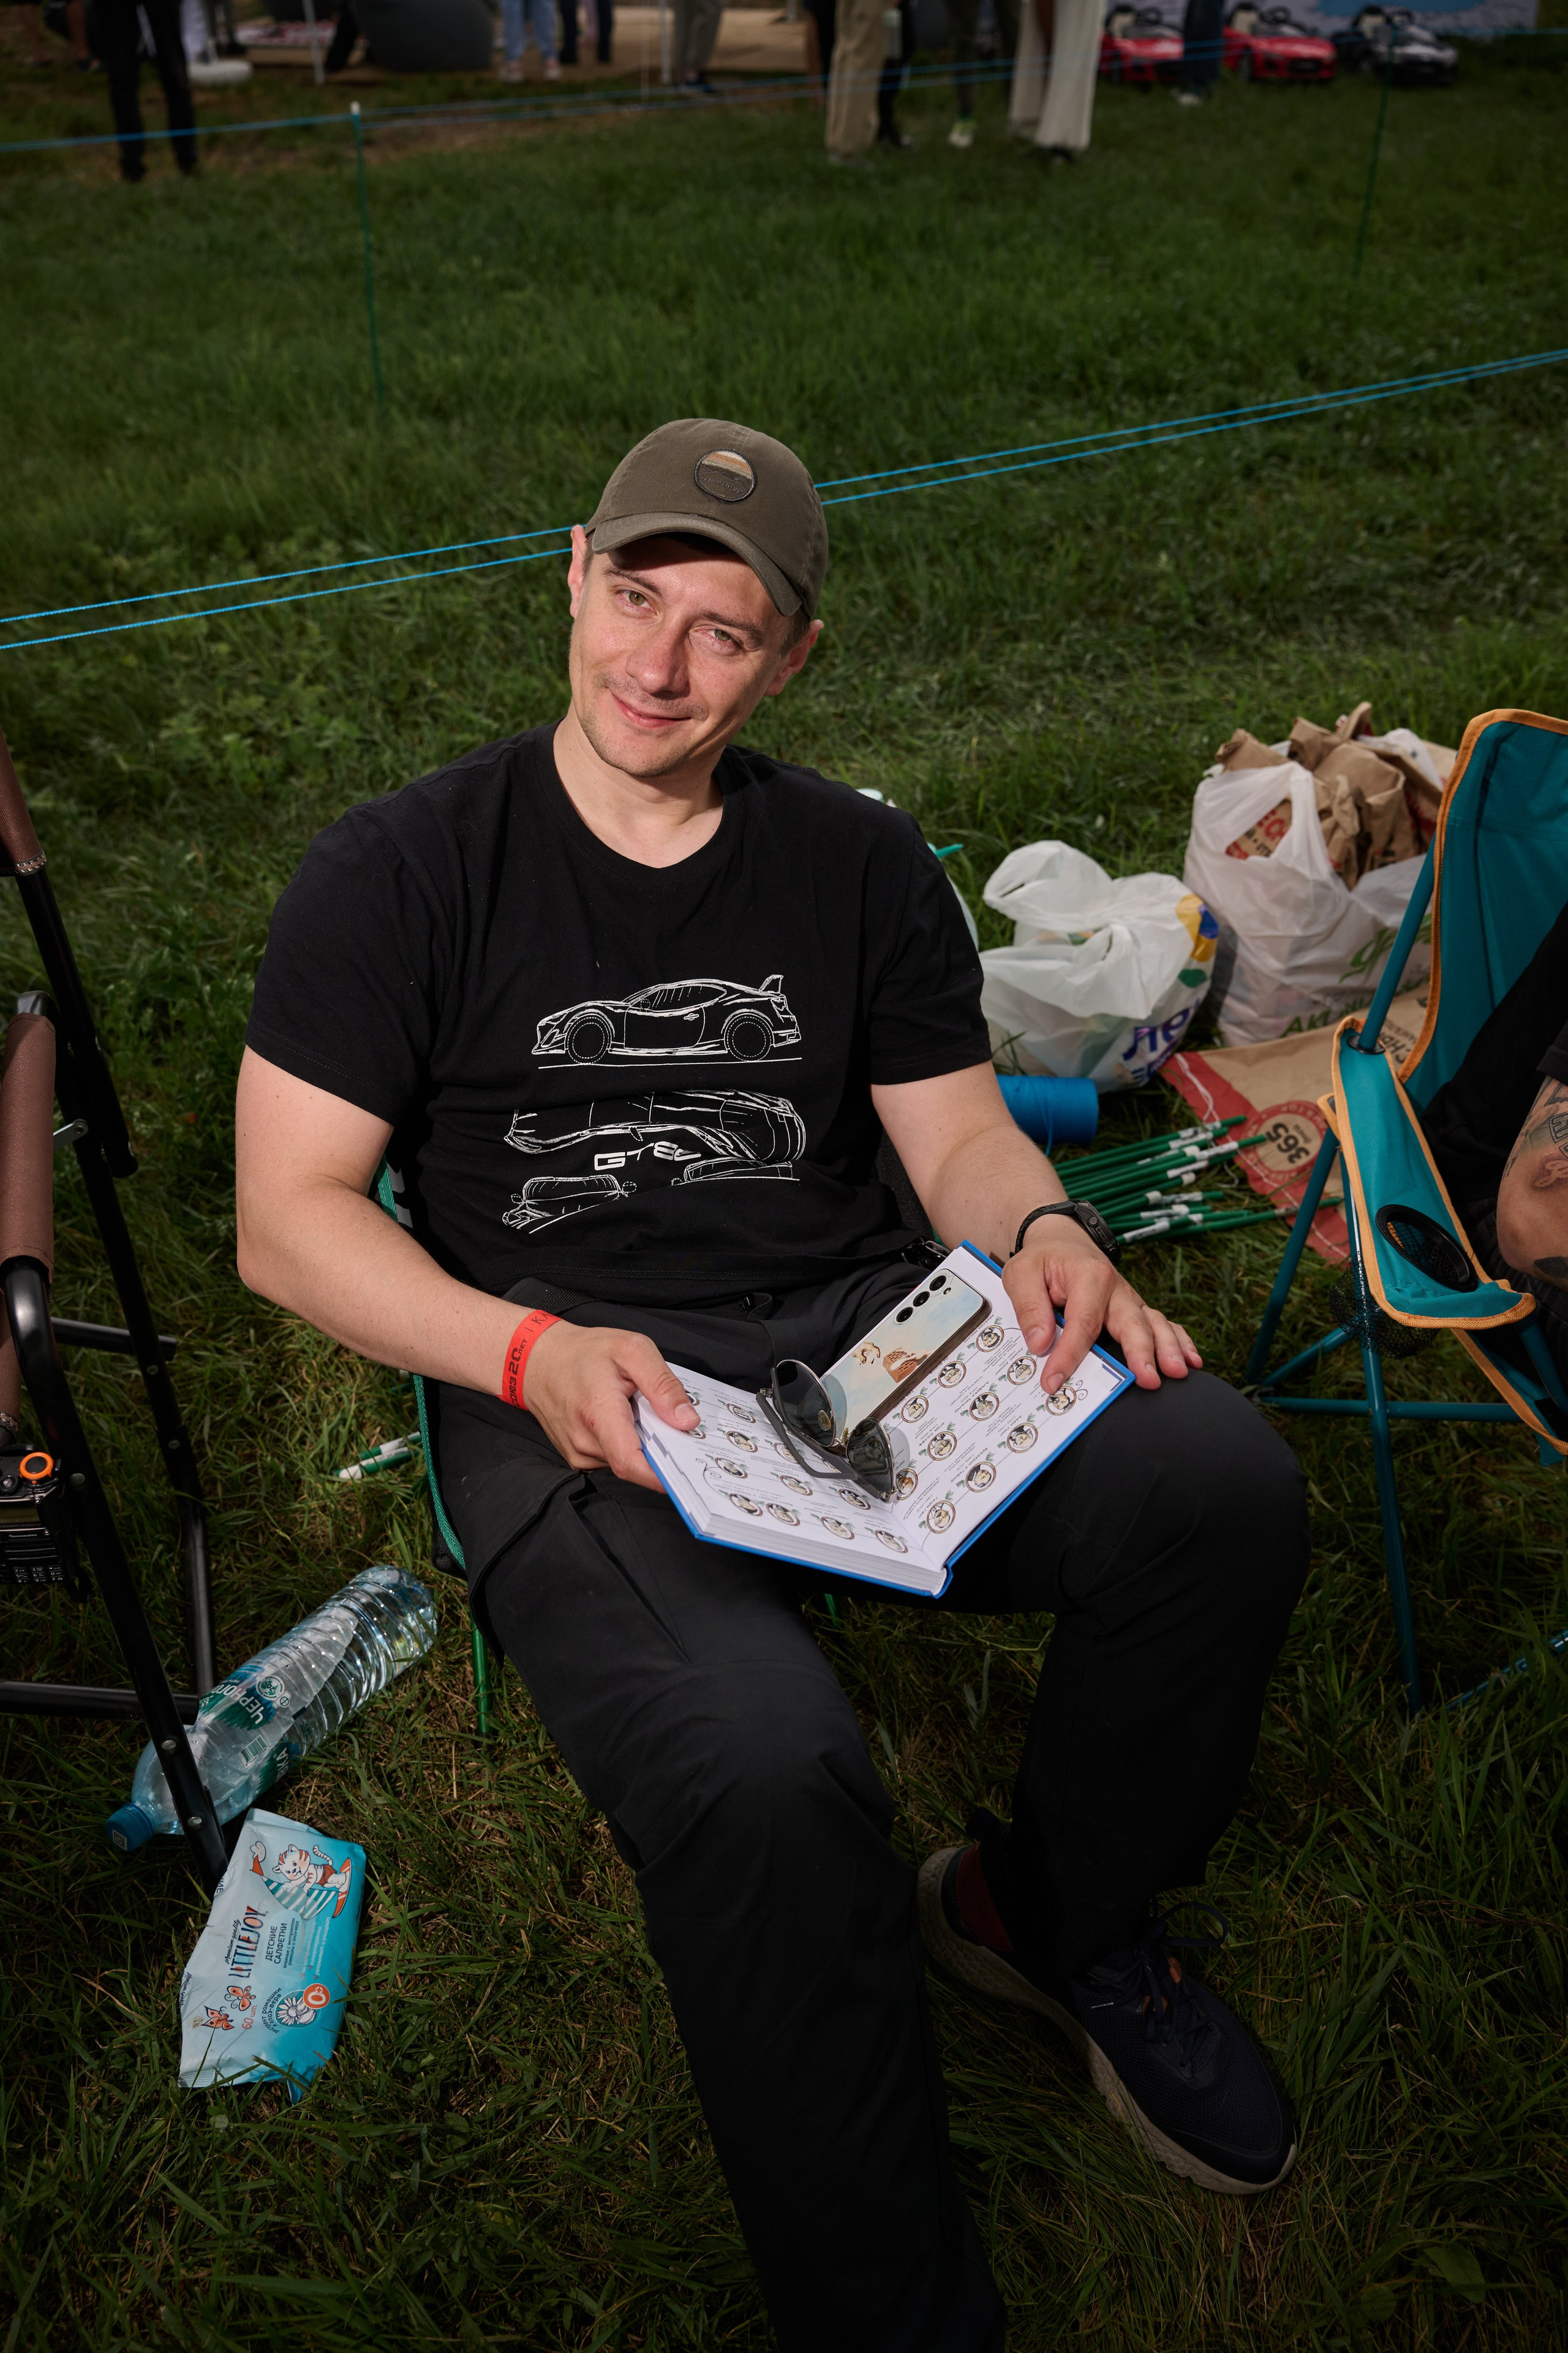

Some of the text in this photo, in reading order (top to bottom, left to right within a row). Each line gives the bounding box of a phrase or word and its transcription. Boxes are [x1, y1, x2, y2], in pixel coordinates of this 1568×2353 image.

[1265, 1122, 1310, 1164] 365
[518, 1339, 527, 1356] ЛЕТ
[225, 1918, 241, 1965] premium quality
[265, 1925, 277, 1961] ДЕТСКИЕ
[274, 1923, 287, 1964] САЛФЕТКИ
[241, 2017, 254, 2030] 60
[262, 1987, 282, 2034] экстракт ромашки
